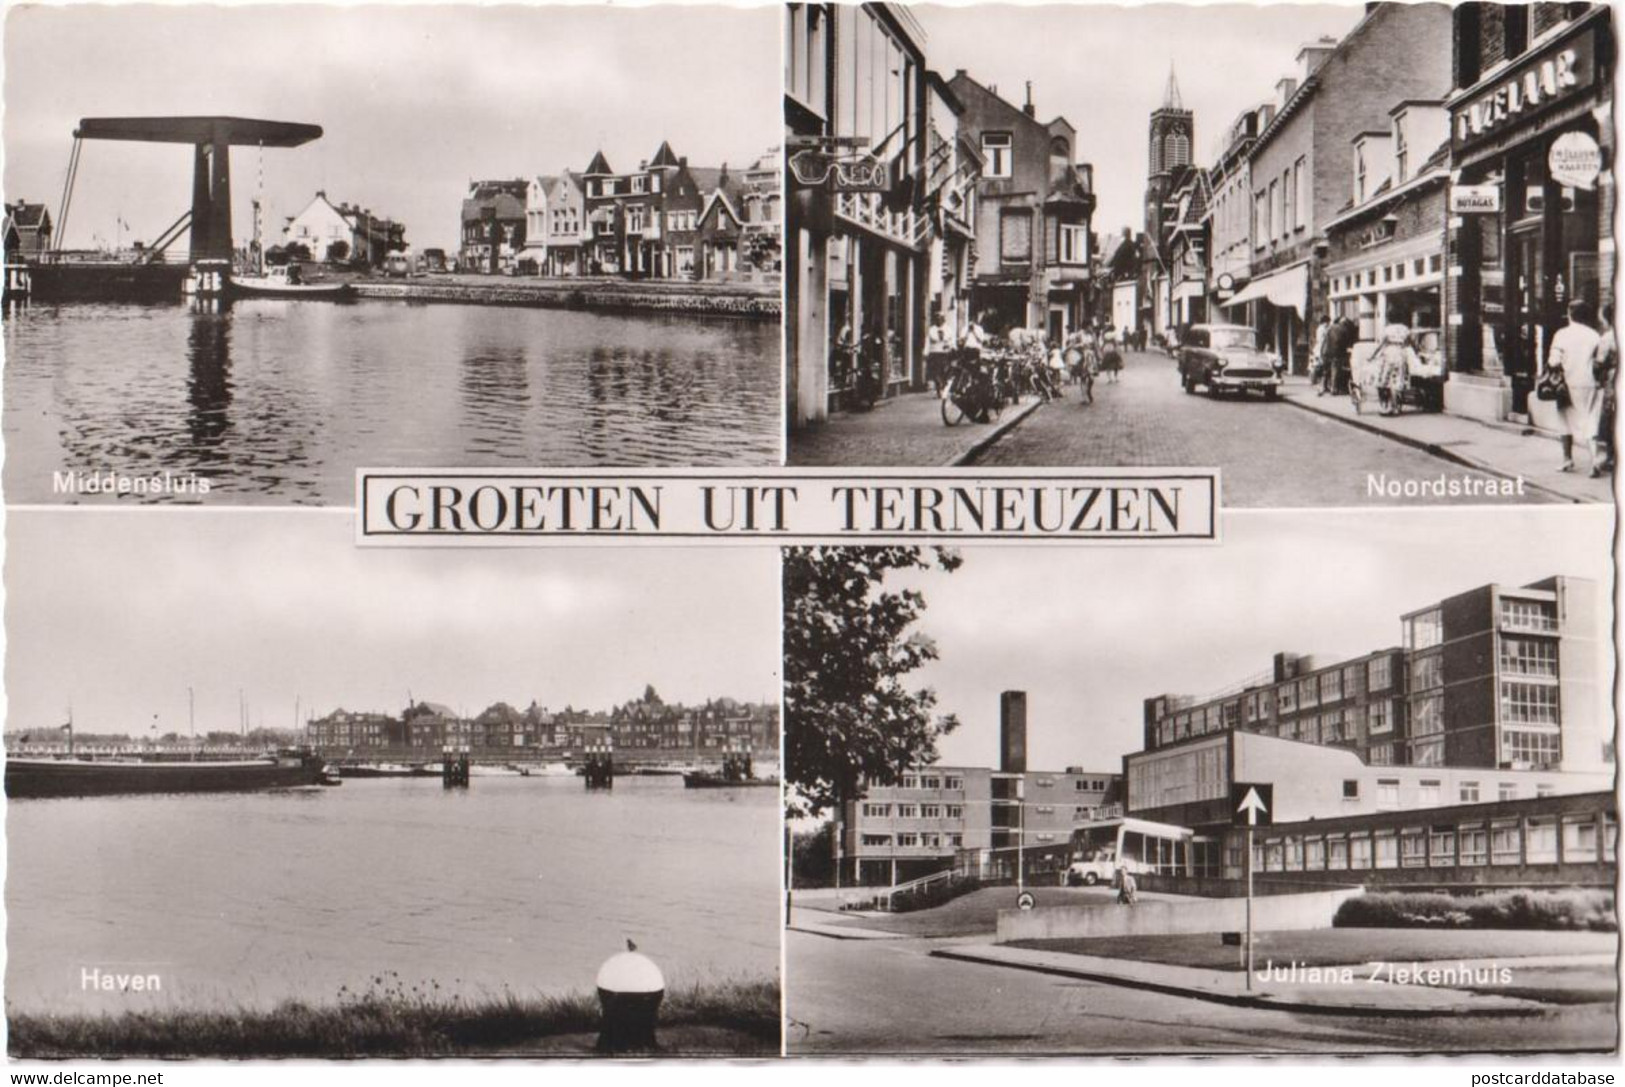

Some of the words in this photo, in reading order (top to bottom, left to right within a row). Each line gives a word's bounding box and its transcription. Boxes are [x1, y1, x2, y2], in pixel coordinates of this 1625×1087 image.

[1457, 198, 1494, 207] BUTAGAS
[52, 470, 212, 495] Middensluis
[1367, 473, 1525, 497] Noordstraat
[386, 487, 661, 533] GROETEN
[704, 487, 798, 532] UIT
[832, 487, 1181, 533] TERNEUZEN
[81, 969, 161, 991] Haven
[1256, 959, 1354, 985] Juliana
